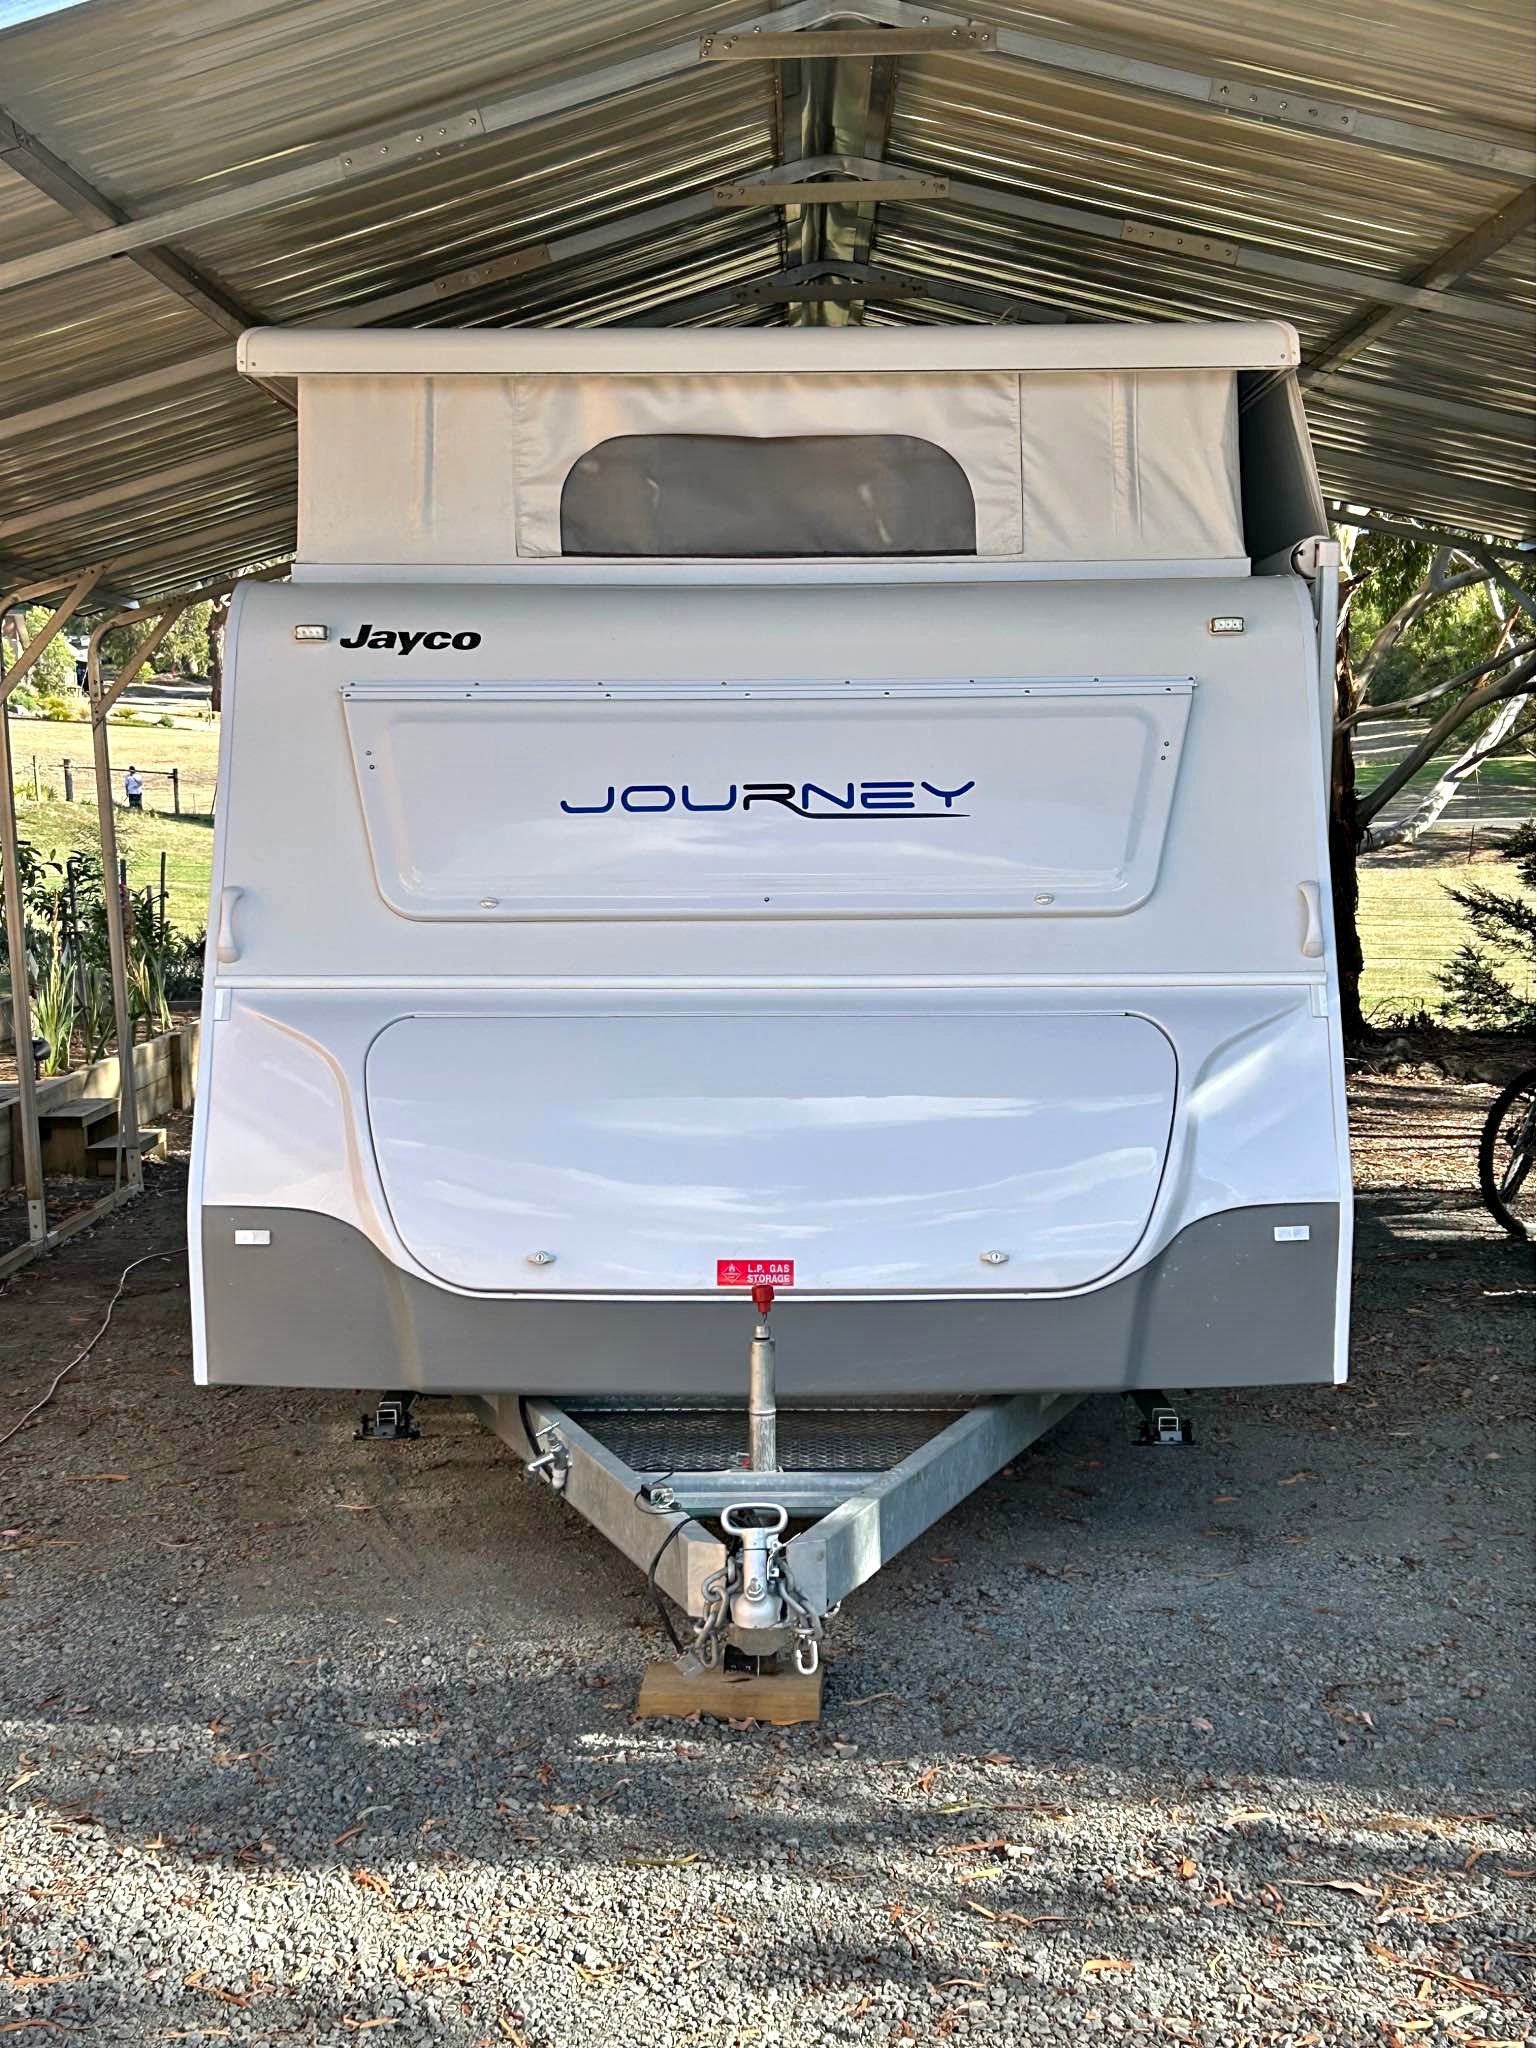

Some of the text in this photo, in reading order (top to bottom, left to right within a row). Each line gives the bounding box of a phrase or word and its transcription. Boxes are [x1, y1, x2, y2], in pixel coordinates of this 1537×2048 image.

[340, 624, 482, 656] Jayco
[560, 781, 975, 819] JOURNEY
[747, 1274, 790, 1284] STORAGE
[748, 1264, 790, 1273] L.P. GAS
